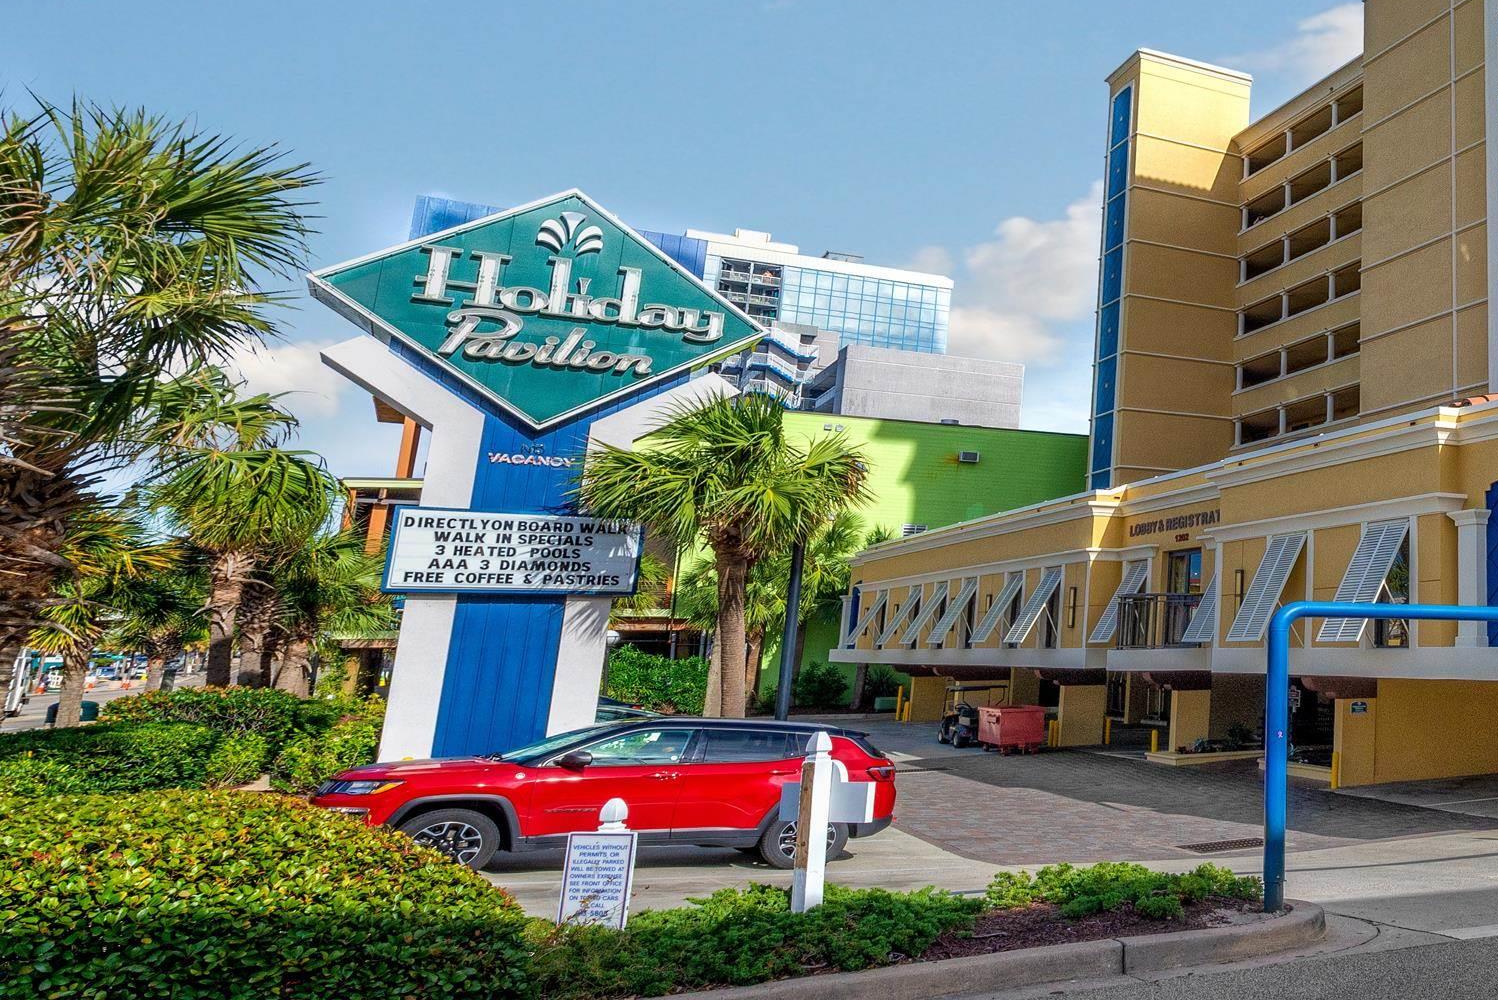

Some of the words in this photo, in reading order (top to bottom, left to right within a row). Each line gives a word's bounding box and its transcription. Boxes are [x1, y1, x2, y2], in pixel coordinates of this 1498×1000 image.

[411, 244, 725, 342] Holiday
[437, 308, 653, 375] Pavilion
[488, 452, 576, 468] VACANCY
[517, 520, 574, 534] BOARD
[580, 523, 628, 535] WALK
[1129, 521, 1157, 537] LOBBY
[1166, 509, 1220, 531] REGISTRAT
[434, 531, 486, 543] WALK
[496, 533, 512, 544] IN
[518, 535, 593, 546] SPECIALS
[435, 545, 445, 556] 3
[453, 546, 517, 557] HEATED
[529, 547, 581, 559] POOLS
[428, 559, 468, 570] AAA
[480, 560, 490, 570] 3
[500, 560, 591, 572] DIAMONDS
[403, 571, 444, 583] FREE
[455, 572, 513, 584] COFFEE
[523, 574, 533, 584] &
[542, 575, 619, 586] PASTRIES
